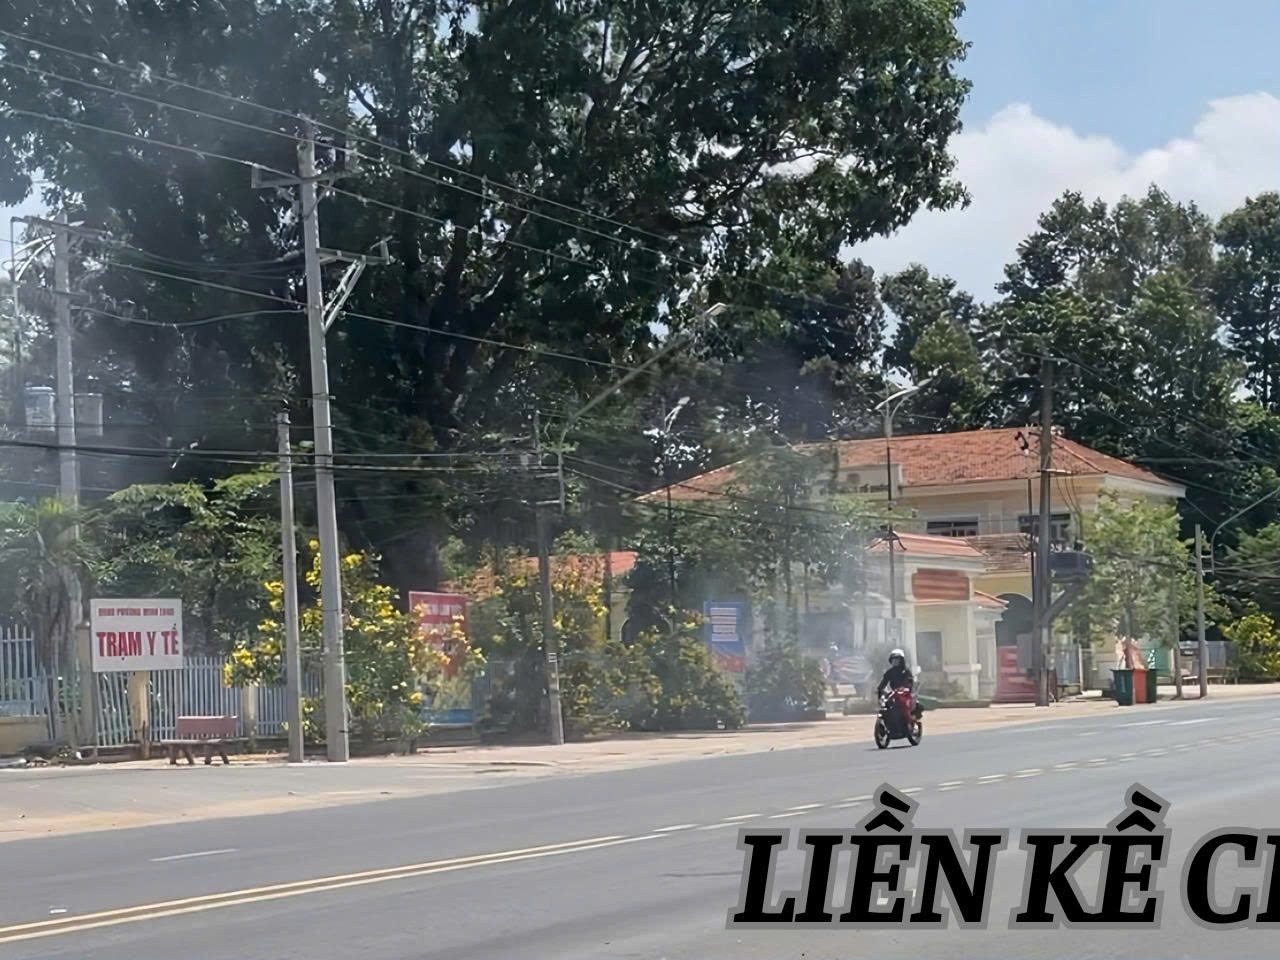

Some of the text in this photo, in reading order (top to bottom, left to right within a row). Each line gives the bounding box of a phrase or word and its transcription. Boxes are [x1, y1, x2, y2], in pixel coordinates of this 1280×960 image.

[96, 623, 179, 661] TRẠM Y TẾ
